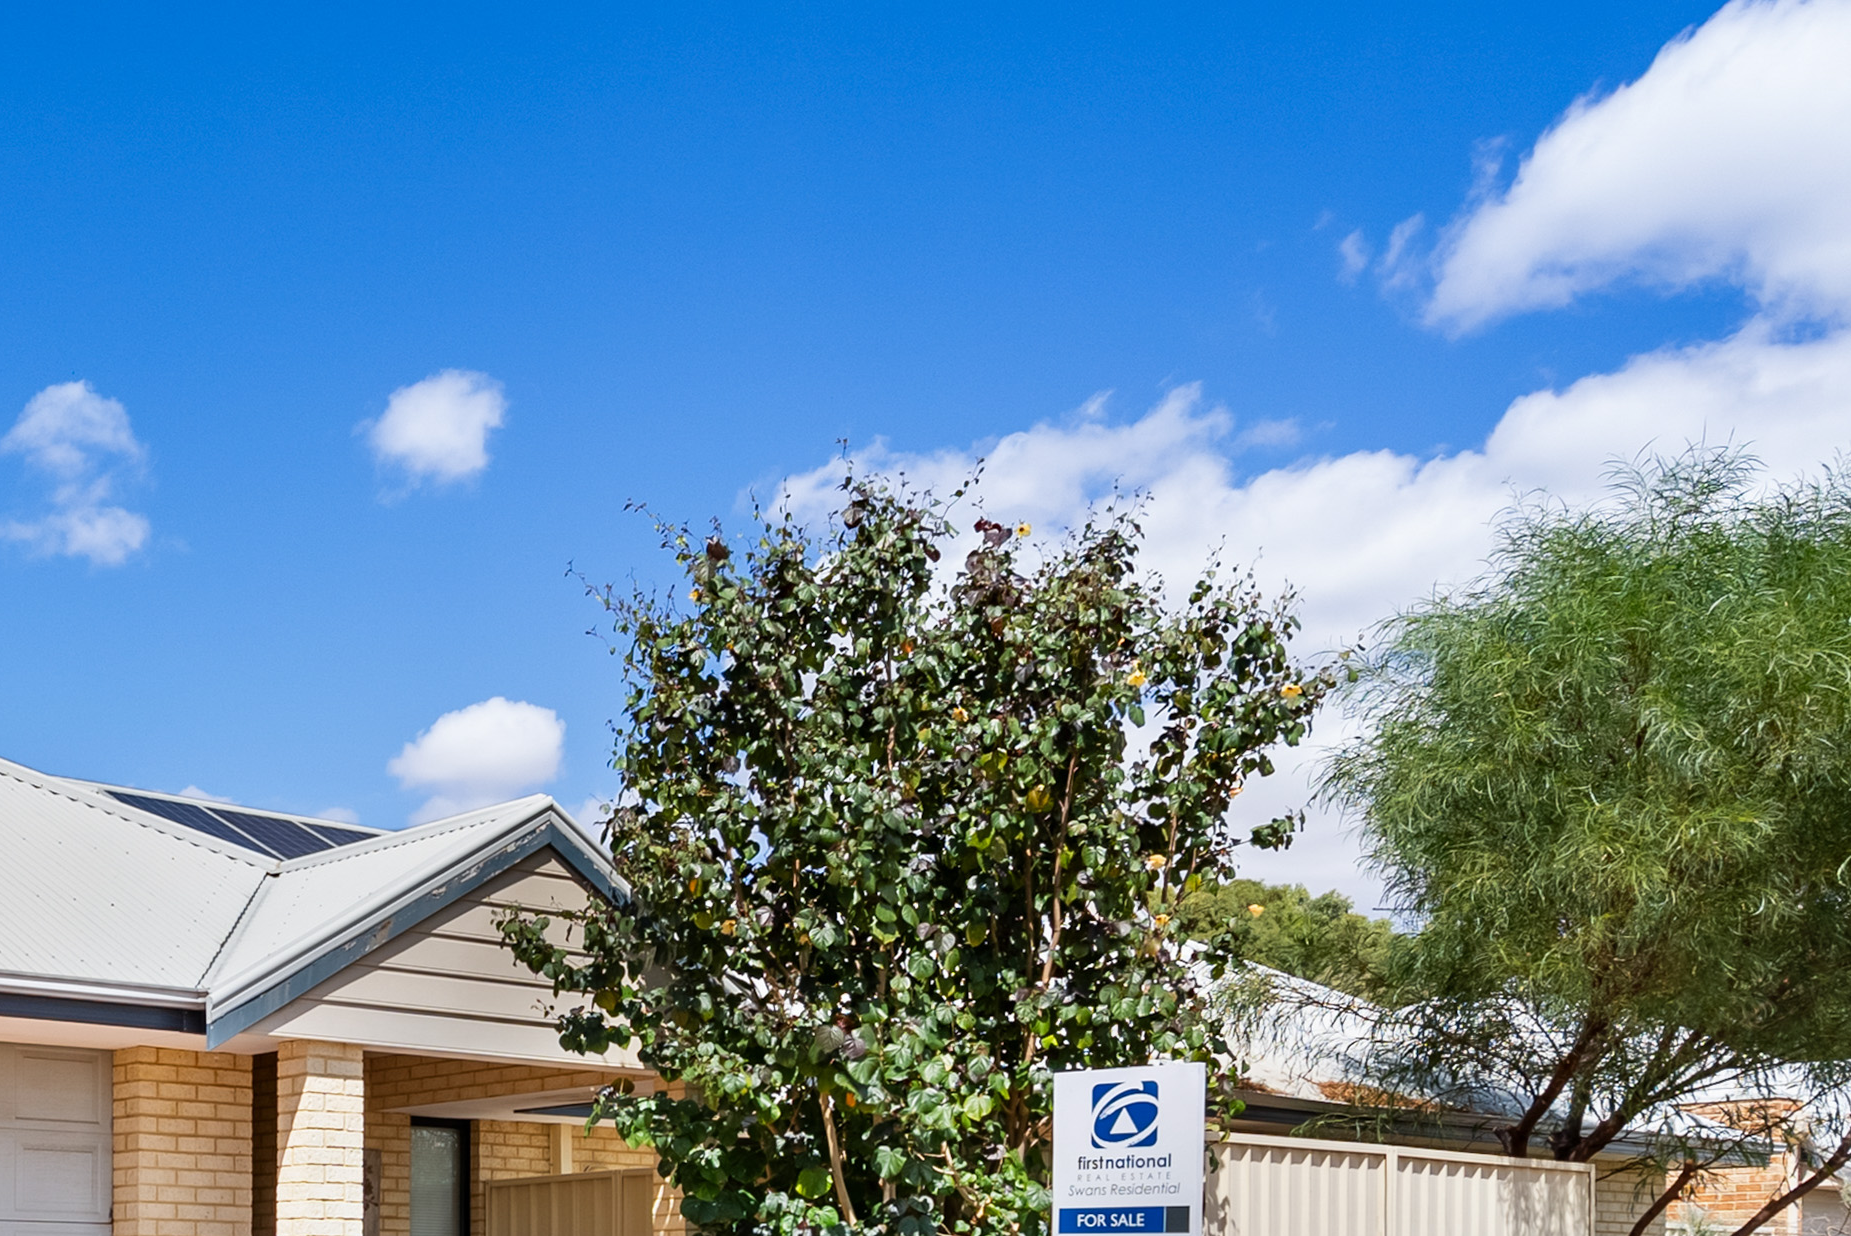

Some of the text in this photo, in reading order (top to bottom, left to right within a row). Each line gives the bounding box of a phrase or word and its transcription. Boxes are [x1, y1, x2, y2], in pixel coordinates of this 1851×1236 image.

[1078, 1153, 1172, 1170] firstnational
[1077, 1171, 1171, 1182] REAL ESTATE
[1068, 1182, 1181, 1197] Swans Residential
[1077, 1213, 1145, 1228] FOR SALE
